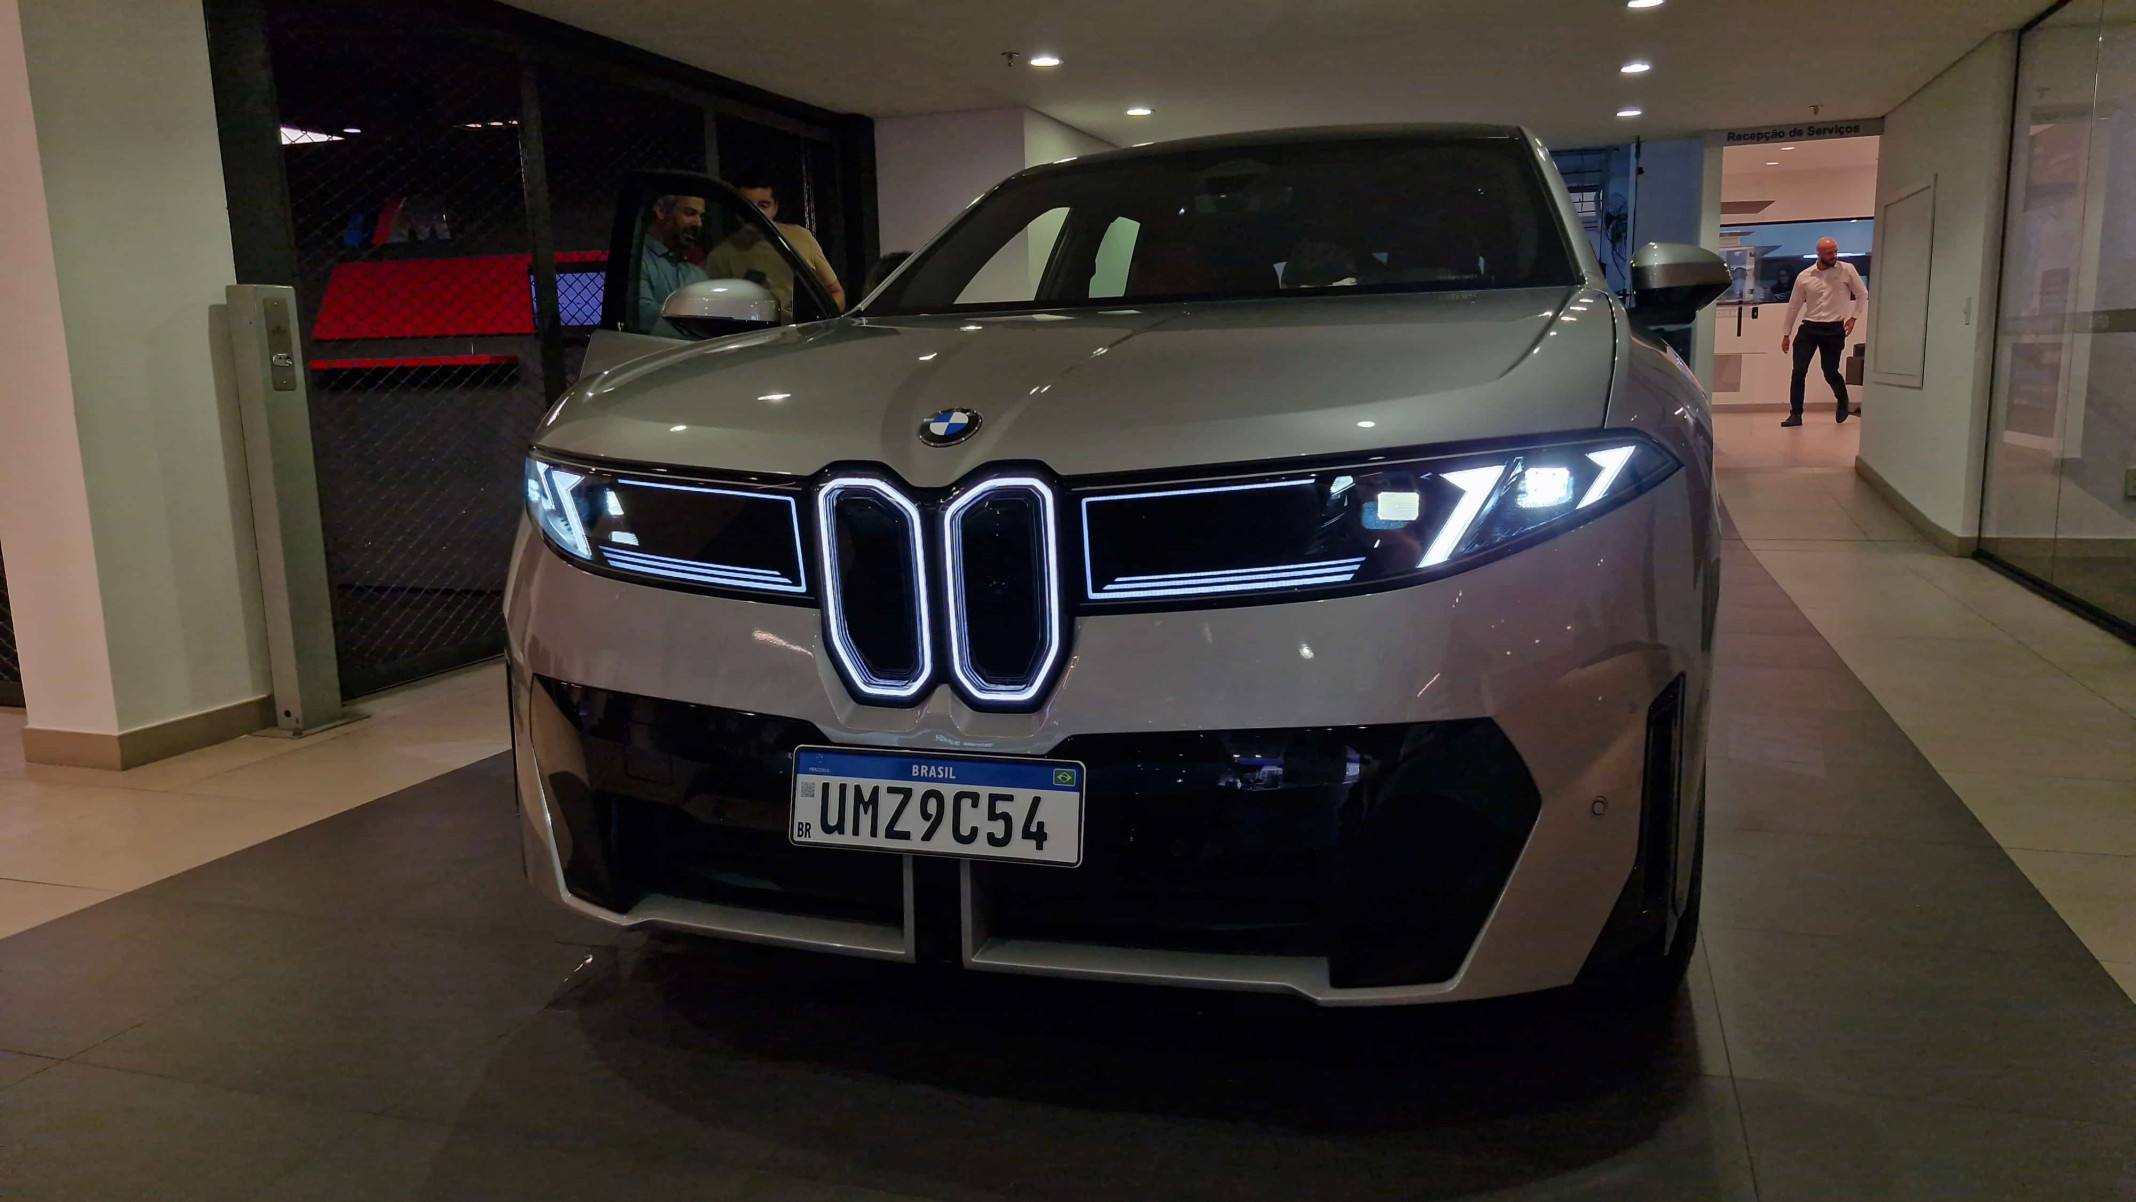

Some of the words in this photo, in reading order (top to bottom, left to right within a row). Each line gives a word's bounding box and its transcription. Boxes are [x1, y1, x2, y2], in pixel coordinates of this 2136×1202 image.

[1727, 129, 1785, 142] Recepção
[1789, 128, 1803, 137] de
[1807, 124, 1861, 137] Serviços
[912, 765, 956, 779] BRASIL
[820, 782, 1048, 851] UMZ9C54
[797, 822, 812, 839] BR
